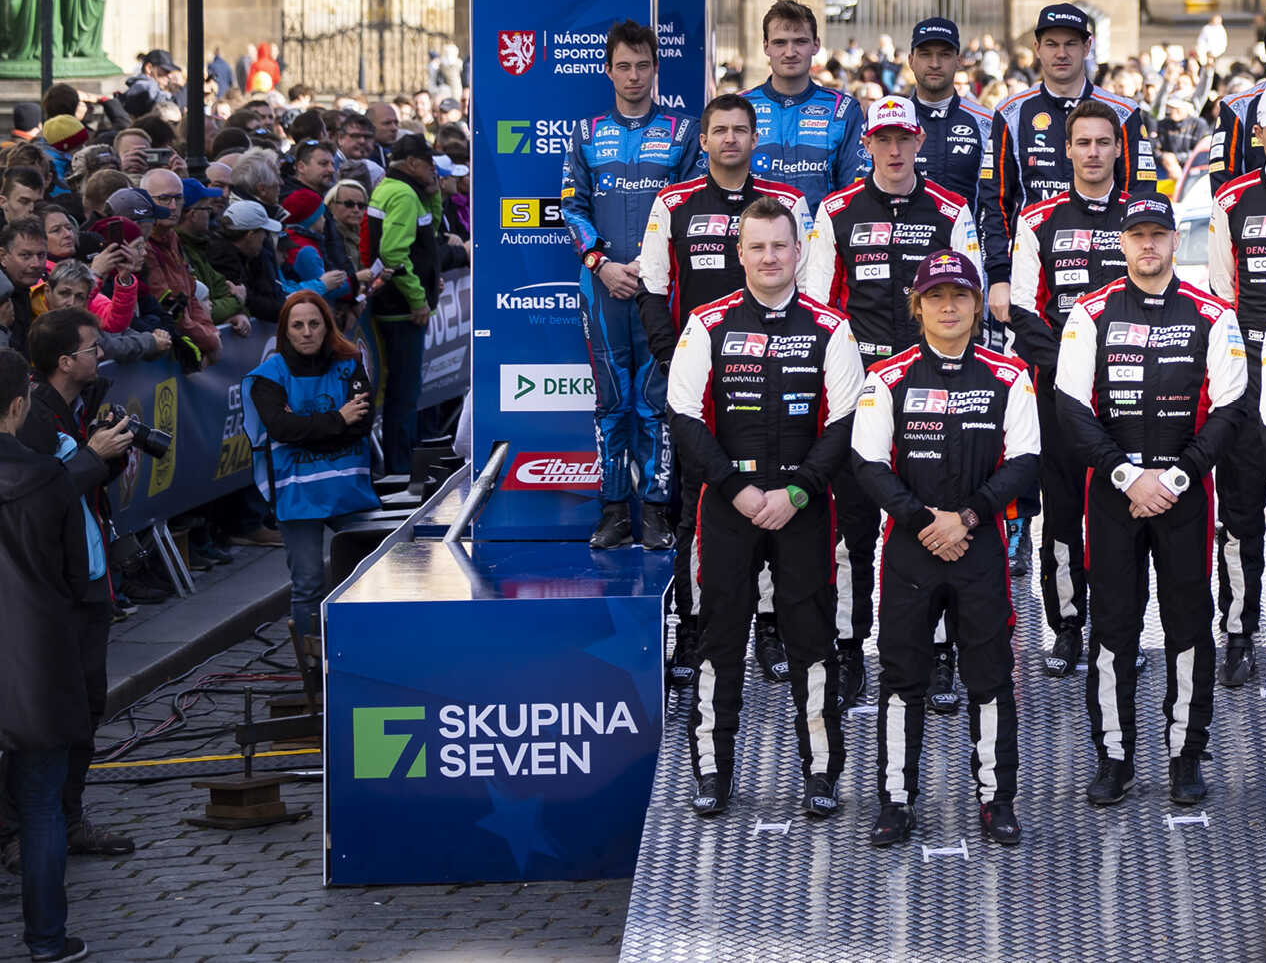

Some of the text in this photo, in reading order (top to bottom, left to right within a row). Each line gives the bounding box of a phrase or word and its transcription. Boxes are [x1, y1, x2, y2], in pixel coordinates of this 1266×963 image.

[553, 29, 608, 45] NÁRODN
[553, 49, 607, 60] SPORTO
[535, 120, 576, 136] SKU
[771, 158, 829, 173] Fleetback
[615, 176, 670, 190] Fleetback
[688, 222, 726, 236] GR
[895, 223, 937, 231] TOYOTA
[500, 232, 572, 245] Automotive
[852, 232, 891, 245] GR
[689, 243, 725, 253] DENSO
[1053, 239, 1091, 251] GR
[855, 253, 889, 263] DENSO
[1055, 258, 1089, 268] DENSO
[1151, 325, 1196, 333] TOYOTA
[771, 335, 817, 344] TOYOTA
[1108, 331, 1148, 347] GR
[724, 340, 764, 357] GR
[1107, 354, 1144, 364] DENSO
[725, 364, 763, 374] DENSO
[543, 377, 597, 396] DEKR
[1109, 389, 1144, 400] UNIBET
[906, 398, 947, 414] GR
[906, 421, 944, 431] DENSO
[438, 701, 640, 739] SKUPINA
